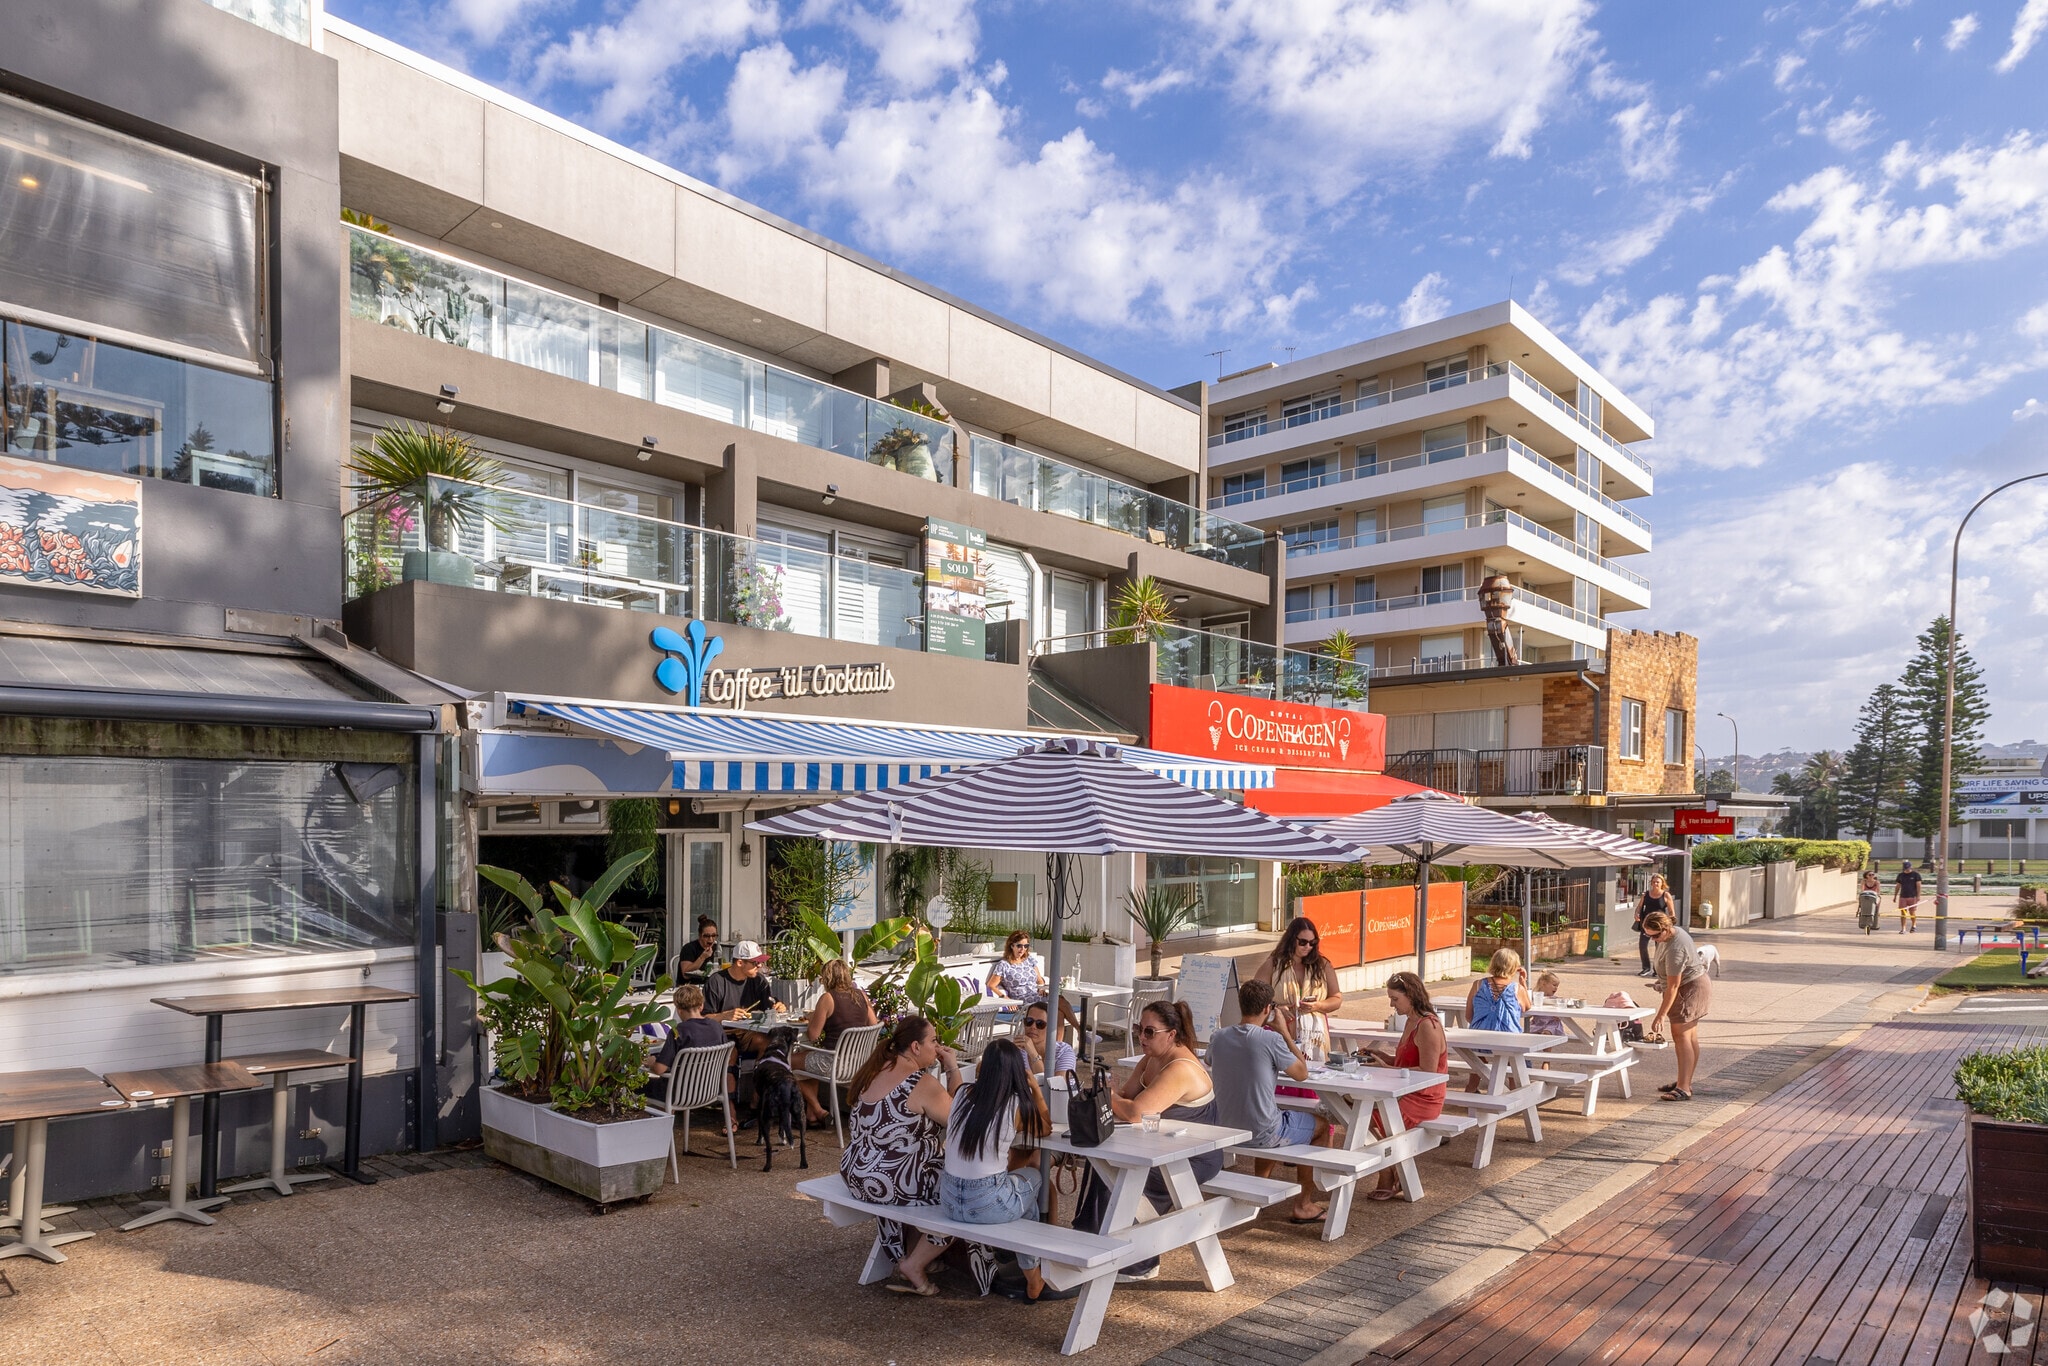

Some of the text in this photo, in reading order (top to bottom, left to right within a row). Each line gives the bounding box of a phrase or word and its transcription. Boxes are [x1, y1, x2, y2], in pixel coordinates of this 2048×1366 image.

[947, 563, 968, 574] SOLD
[708, 667, 773, 711] Coffee
[811, 662, 895, 695] Cocktails
[1270, 711, 1303, 720] ROYAL
[1227, 707, 1336, 747] COPENHAGEN
[1235, 744, 1248, 752] ICE
[1251, 746, 1276, 754] CREAM
[1287, 749, 1315, 757] DESSERT
[1368, 914, 1411, 933] COPENHAGEN
